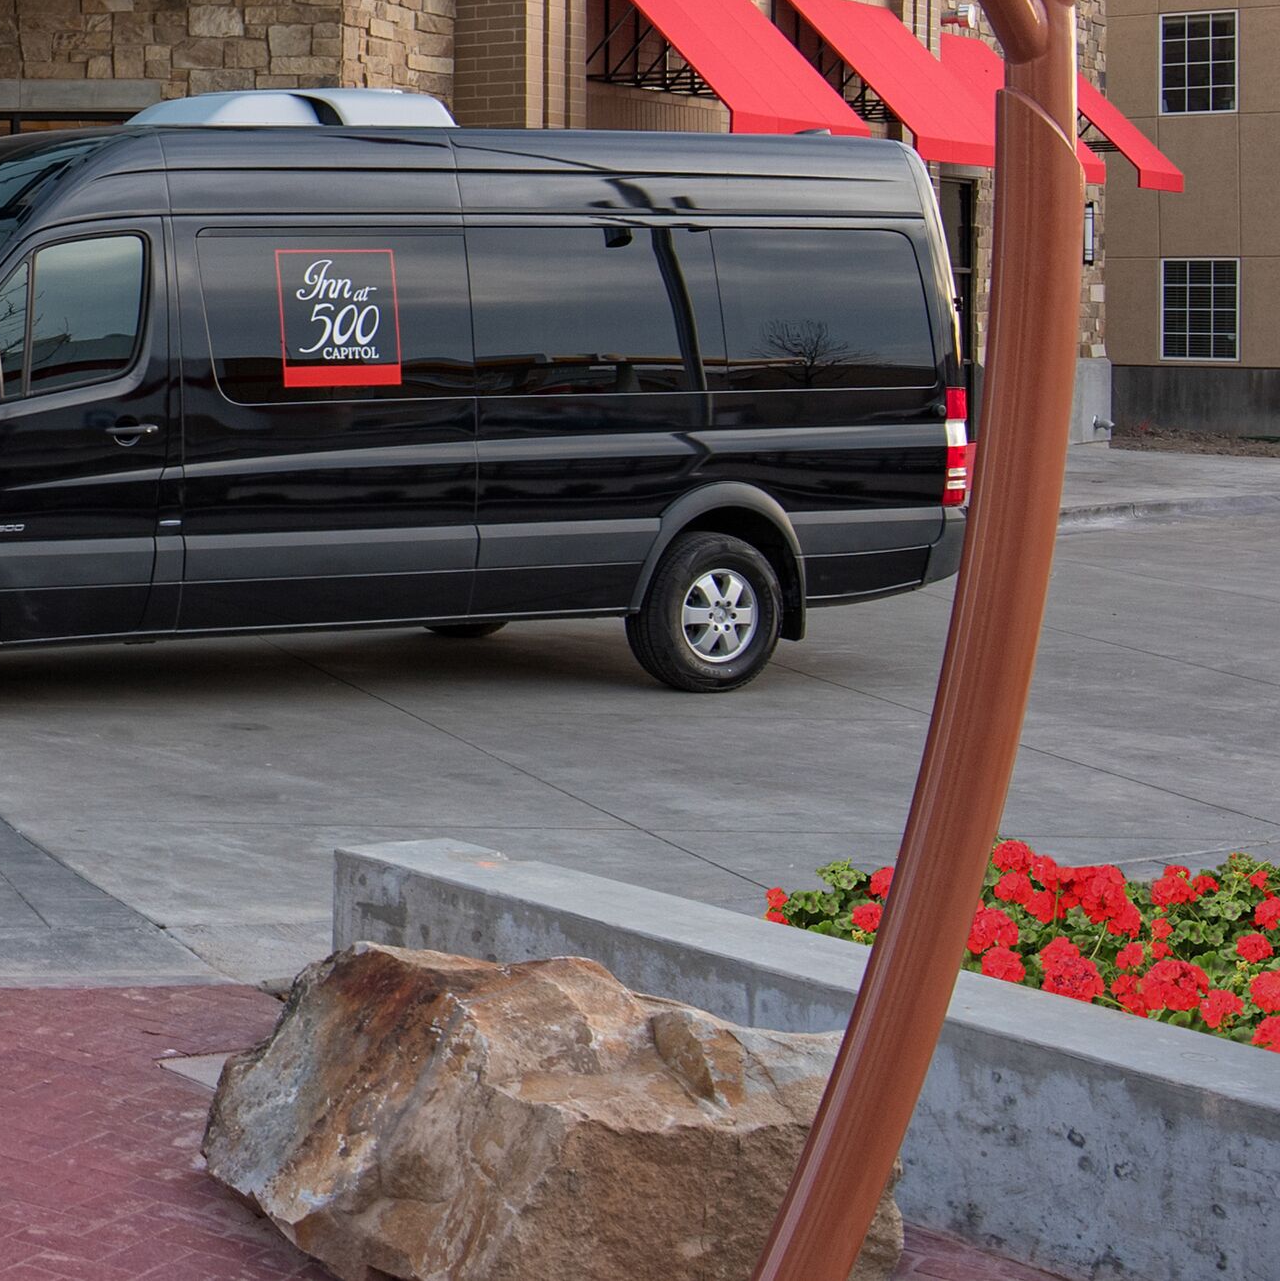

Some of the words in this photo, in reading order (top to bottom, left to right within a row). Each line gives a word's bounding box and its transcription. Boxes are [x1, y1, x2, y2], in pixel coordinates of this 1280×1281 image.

[296, 259, 353, 301] Inn
[353, 287, 378, 302] at
[299, 303, 380, 354] 500
[323, 346, 380, 360] CAPITOL
